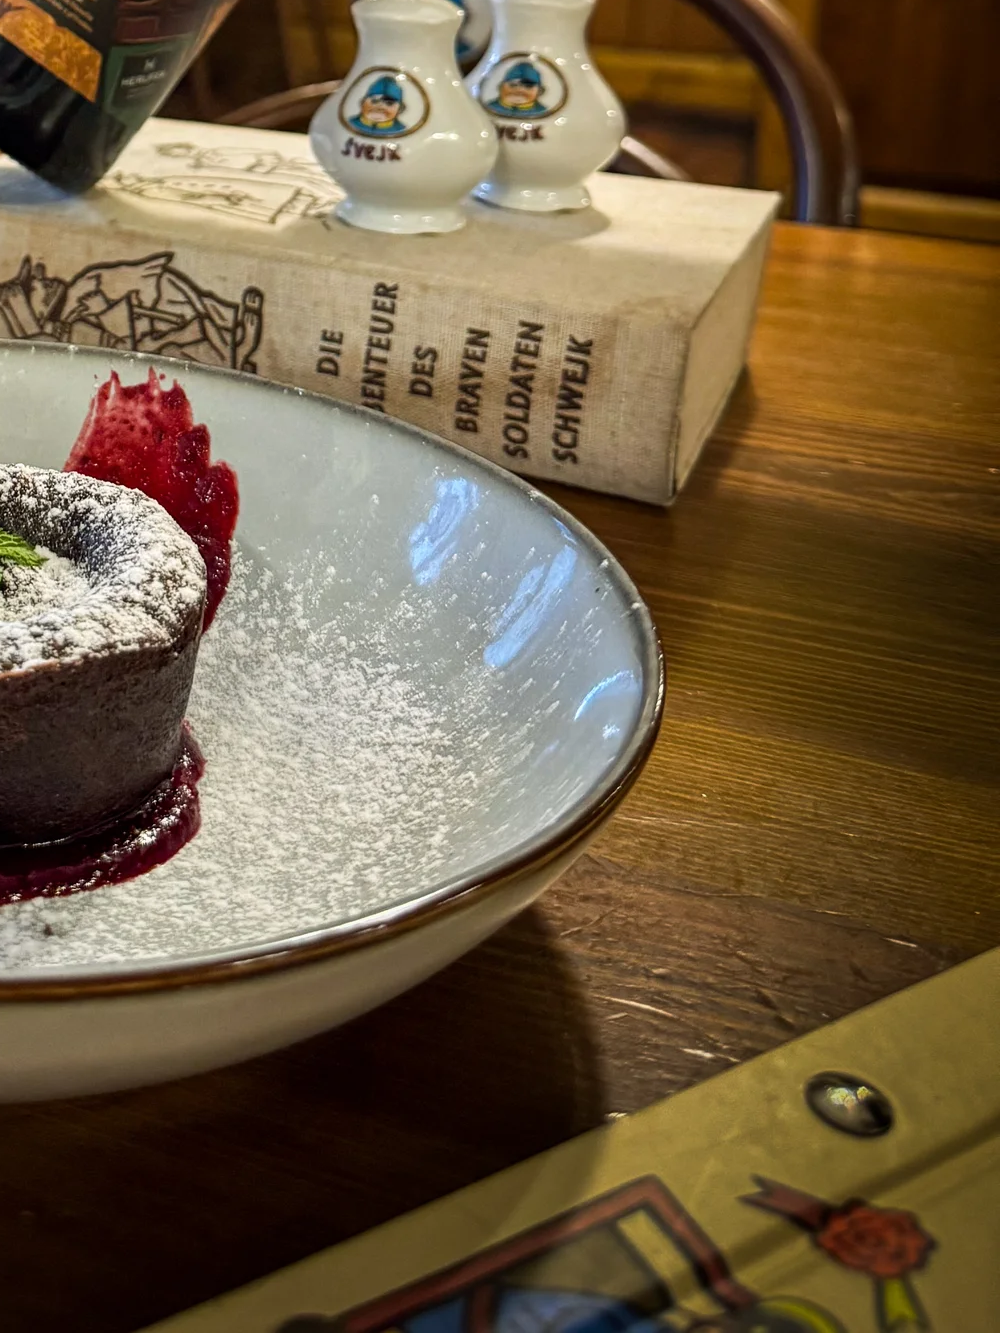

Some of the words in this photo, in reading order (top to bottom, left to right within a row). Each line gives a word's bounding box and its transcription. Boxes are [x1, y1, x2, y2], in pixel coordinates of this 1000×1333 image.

[316, 328, 344, 377] DIE
[408, 345, 438, 397] DES
[455, 327, 490, 433] BRAVEN
[502, 320, 545, 459] SOLDATEN
[552, 334, 593, 464] SCHWEJK
